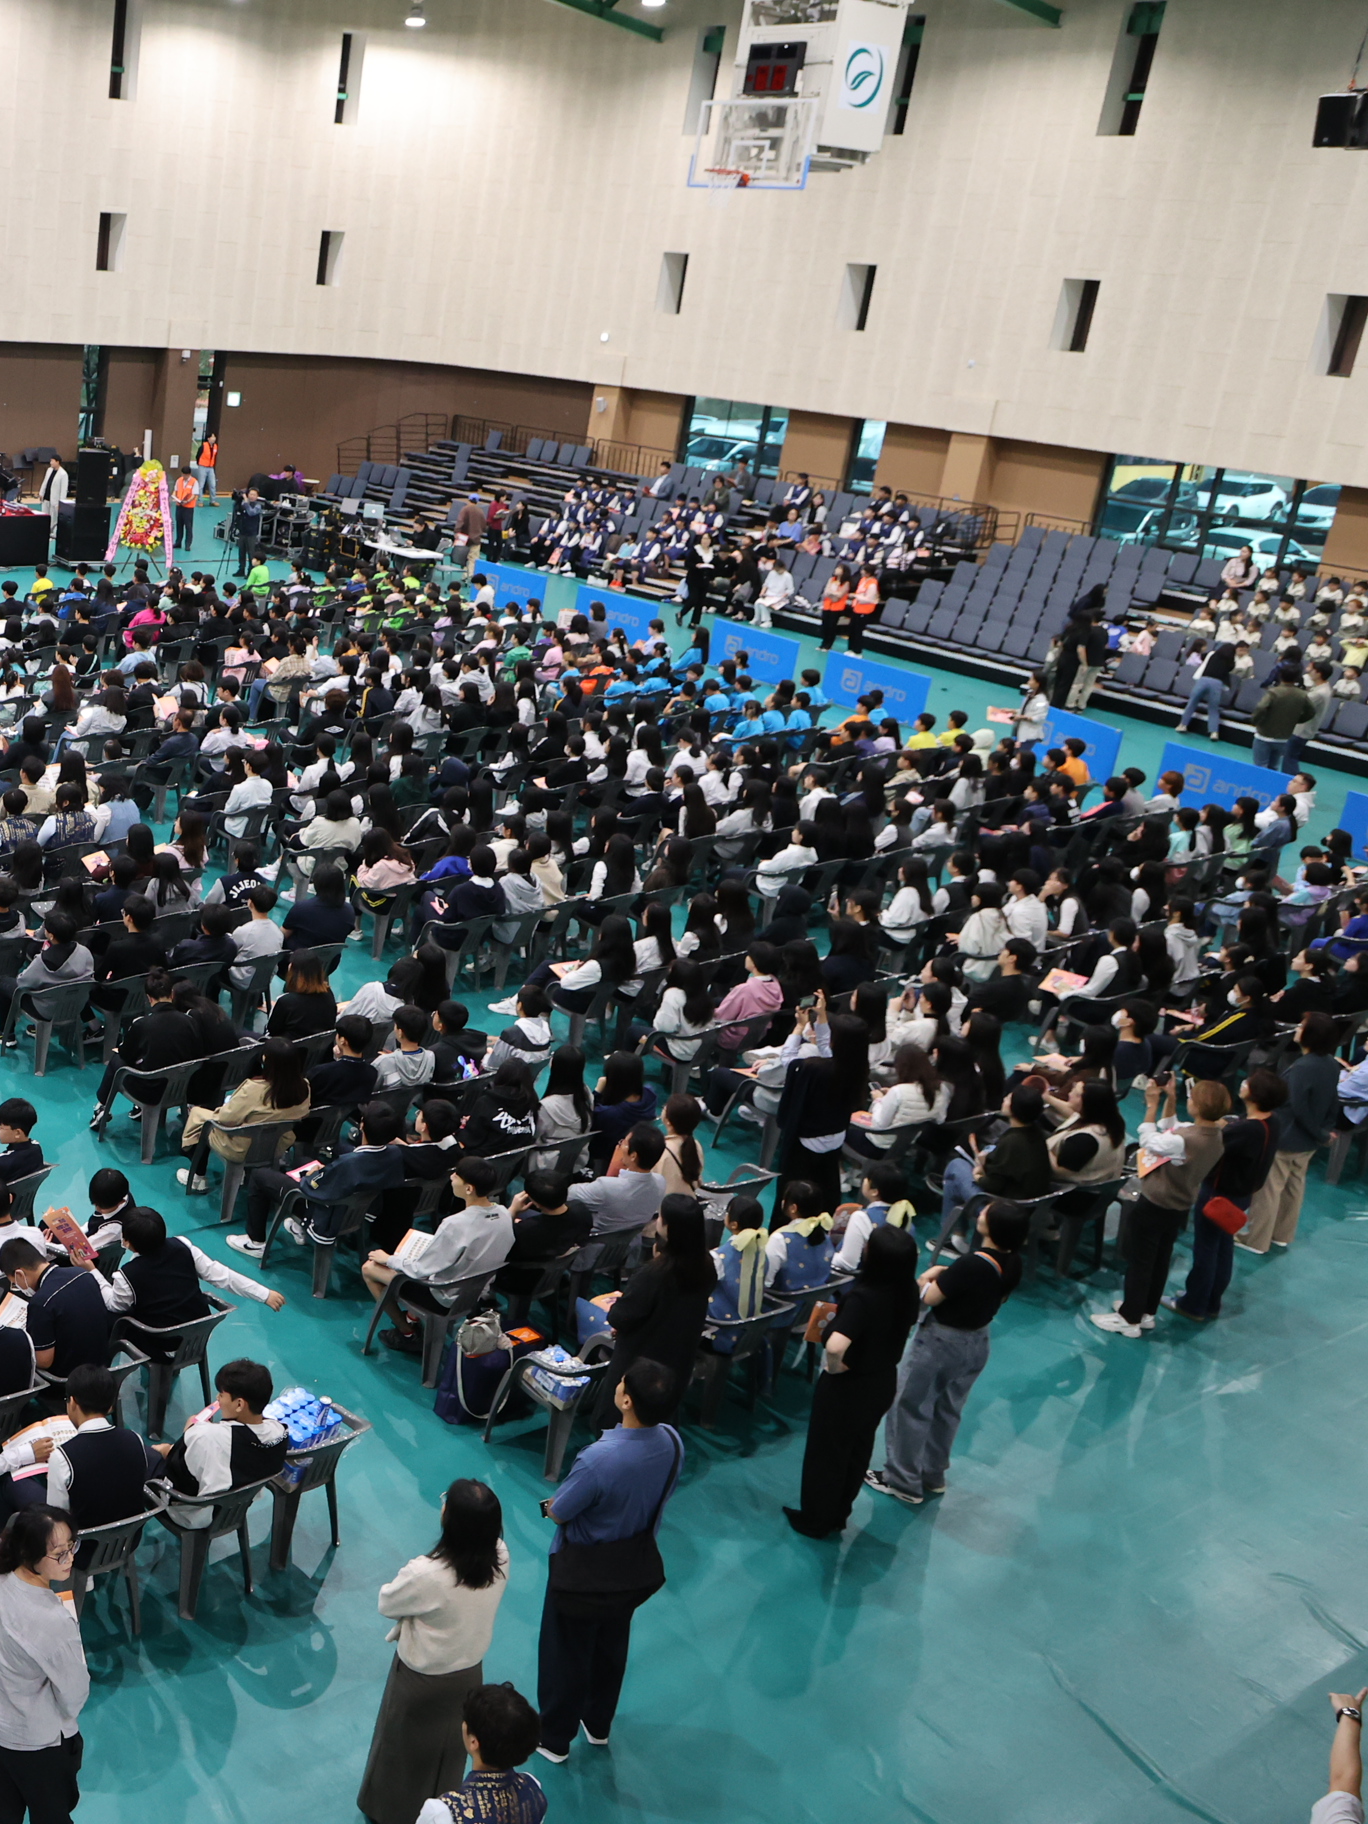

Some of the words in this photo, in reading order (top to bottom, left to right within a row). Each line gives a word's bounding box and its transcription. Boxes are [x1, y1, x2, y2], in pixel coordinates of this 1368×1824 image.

[501, 582, 530, 598] andro
[606, 610, 640, 627] andro
[1212, 779, 1271, 806] andro
[229, 879, 261, 899] JIJEO
